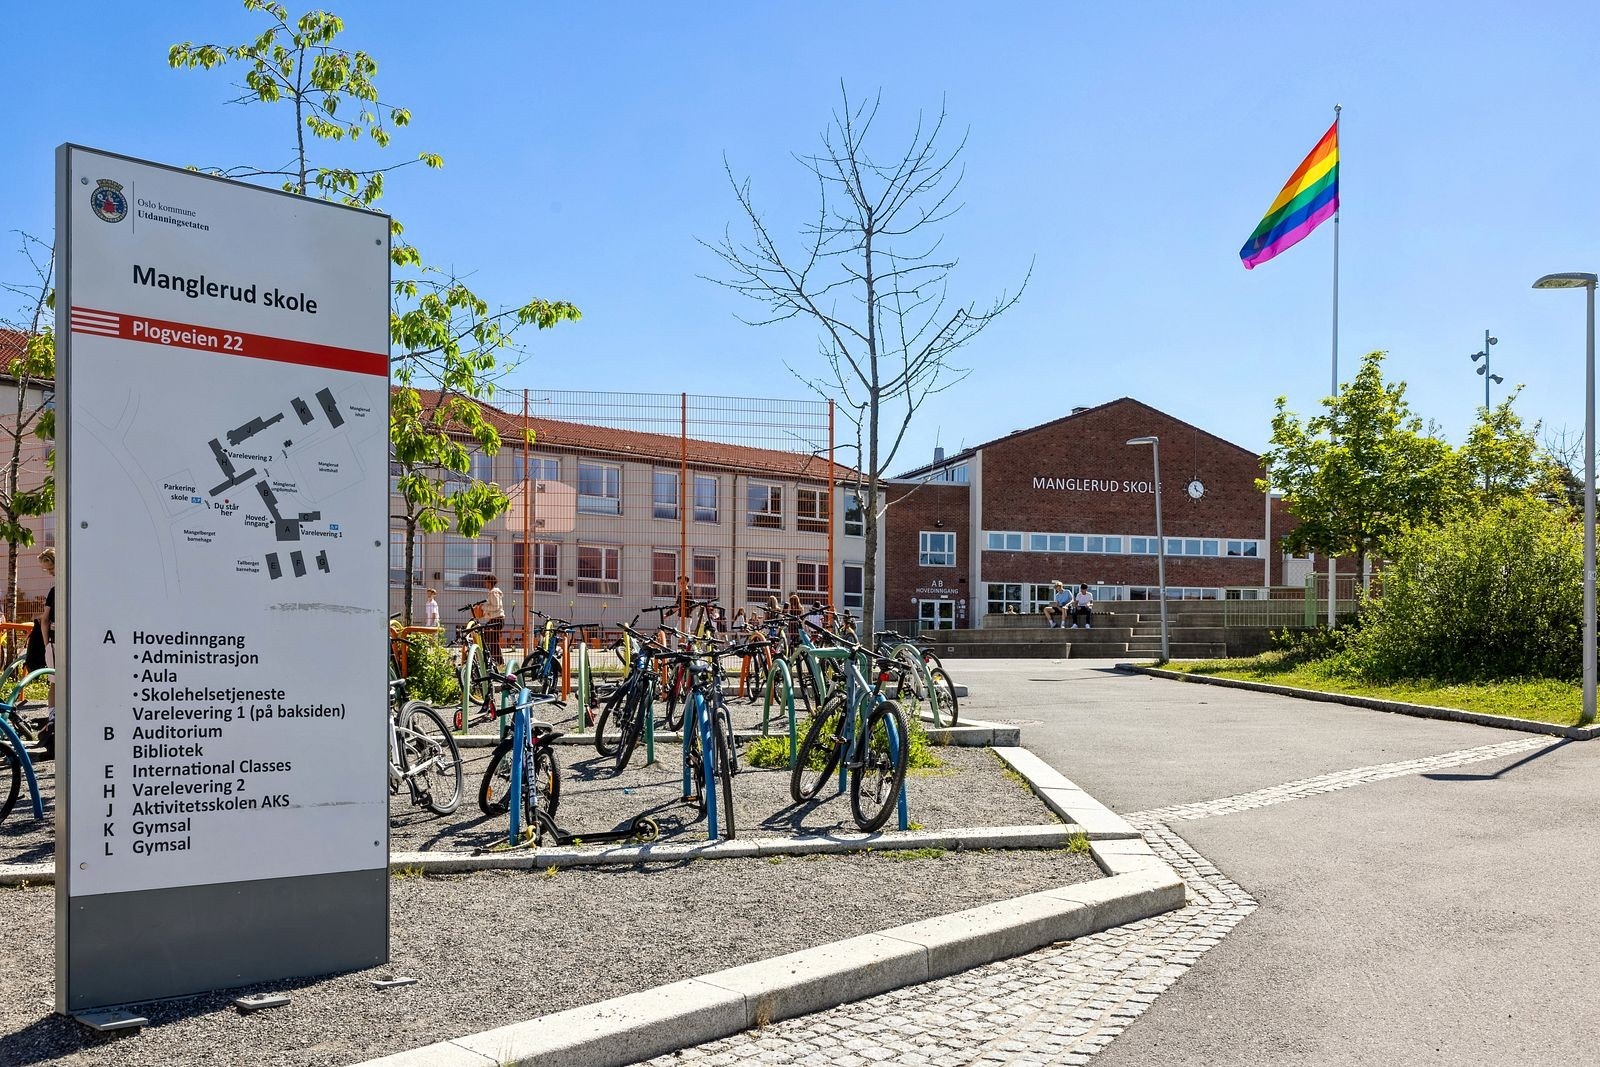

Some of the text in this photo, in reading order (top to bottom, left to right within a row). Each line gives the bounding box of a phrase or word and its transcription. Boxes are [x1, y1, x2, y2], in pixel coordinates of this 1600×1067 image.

[137, 199, 197, 218] Oslo kommune
[137, 210, 210, 231] Utdanningsetaten
[132, 264, 318, 314] Manglerud skole
[132, 320, 244, 351] Plogveien 22
[228, 452, 268, 463] Varelevering
[164, 483, 196, 493] Parkering
[1033, 477, 1119, 493] MANGLERUD
[244, 519, 270, 529] inngang
[245, 514, 268, 522] Hoved-
[300, 529, 338, 538] Varelevering
[103, 630, 245, 649] A Hovedinngang
[141, 650, 259, 667] Administrasjon
[141, 669, 178, 682] Aula
[141, 688, 286, 704] Skolehelsetjeneste
[132, 704, 346, 722] Varelevering 1 (på baksiden)
[104, 726, 223, 740] B Auditorium
[133, 743, 204, 758] Bibliotek
[105, 760, 292, 779] E International Classes
[104, 779, 245, 798] H Varelevering 2
[106, 794, 290, 818] J Aktivitetsskolen AKS
[104, 818, 191, 837] K Gymsal
[105, 836, 191, 856] L Gymsal
